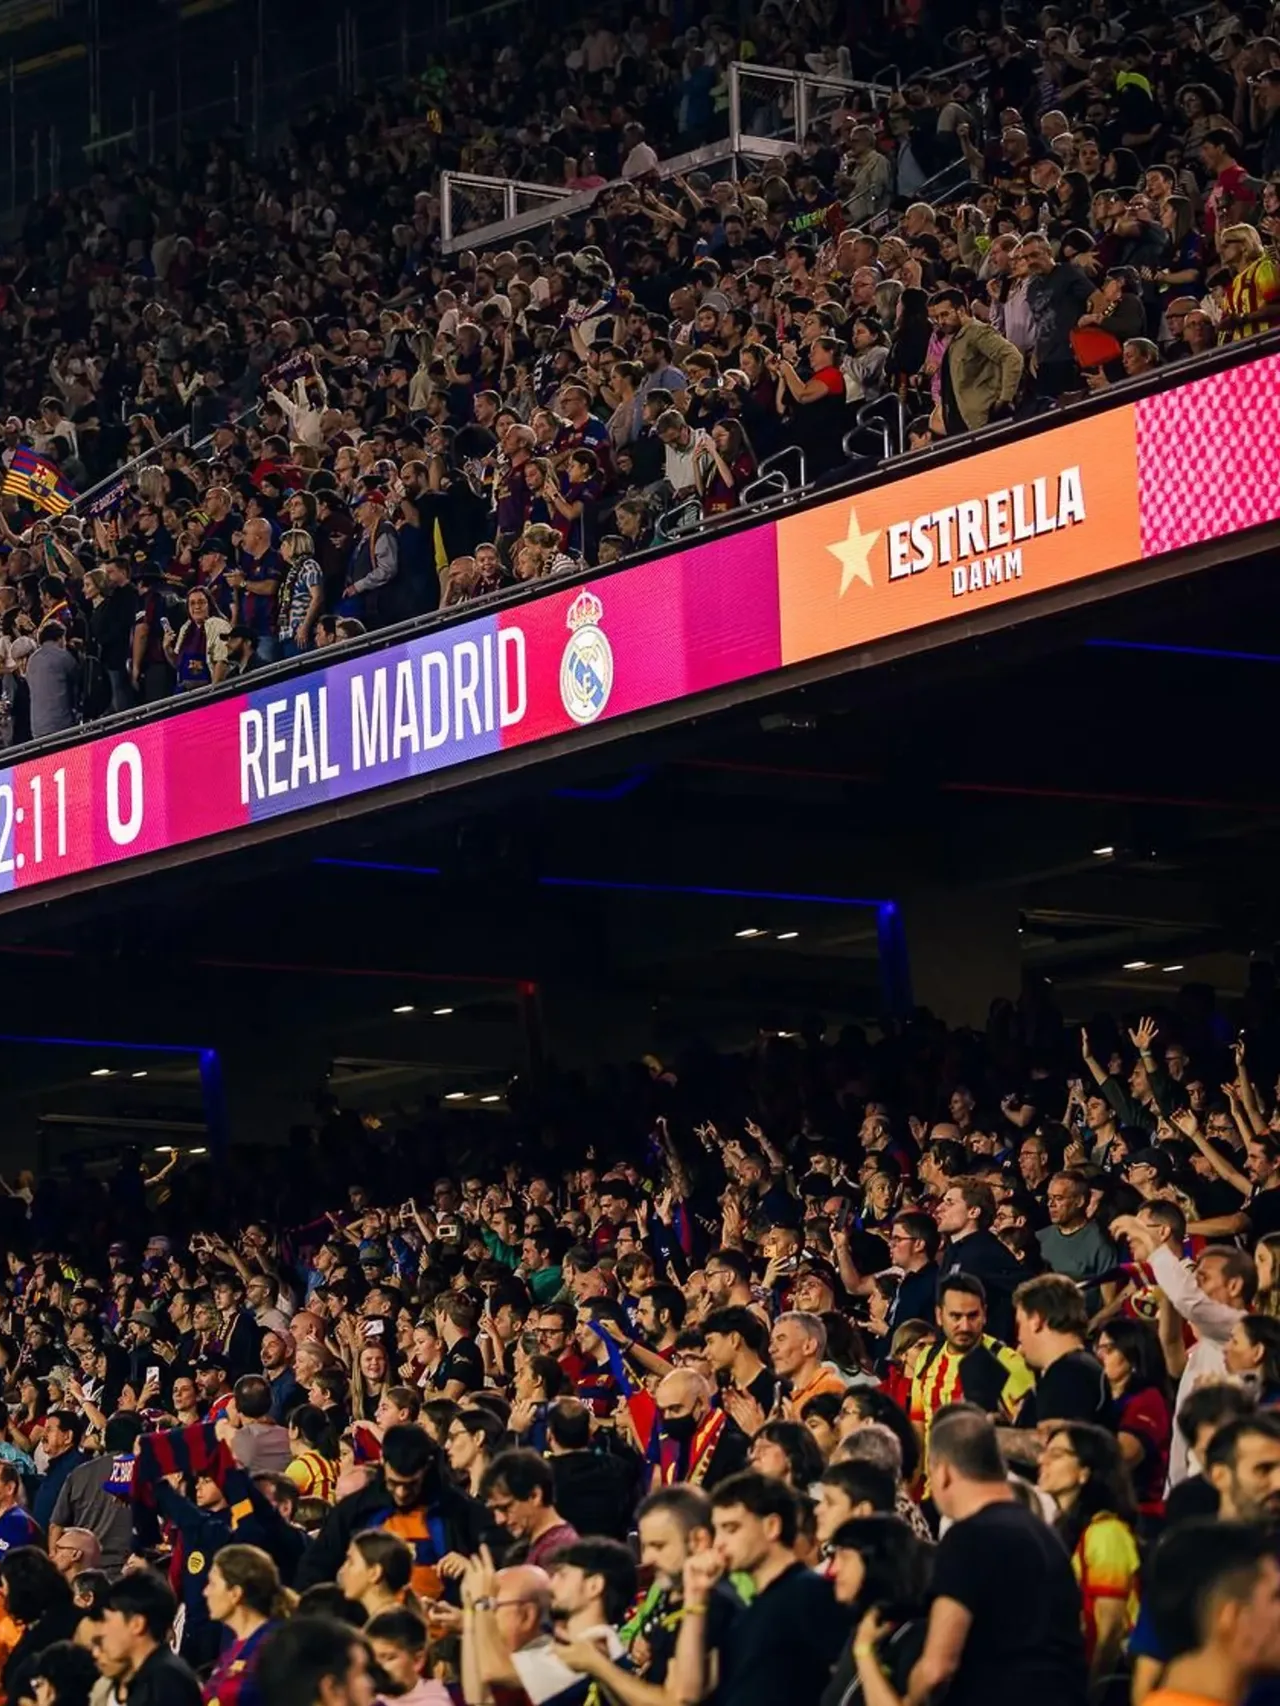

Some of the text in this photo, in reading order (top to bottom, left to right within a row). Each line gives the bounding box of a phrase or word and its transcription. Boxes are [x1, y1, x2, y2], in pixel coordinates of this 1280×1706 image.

[887, 465, 1086, 582] ESTRELLA
[952, 548, 1023, 596] DAMM
[239, 626, 527, 804] REAL MADRID
[106, 742, 143, 845] 0
